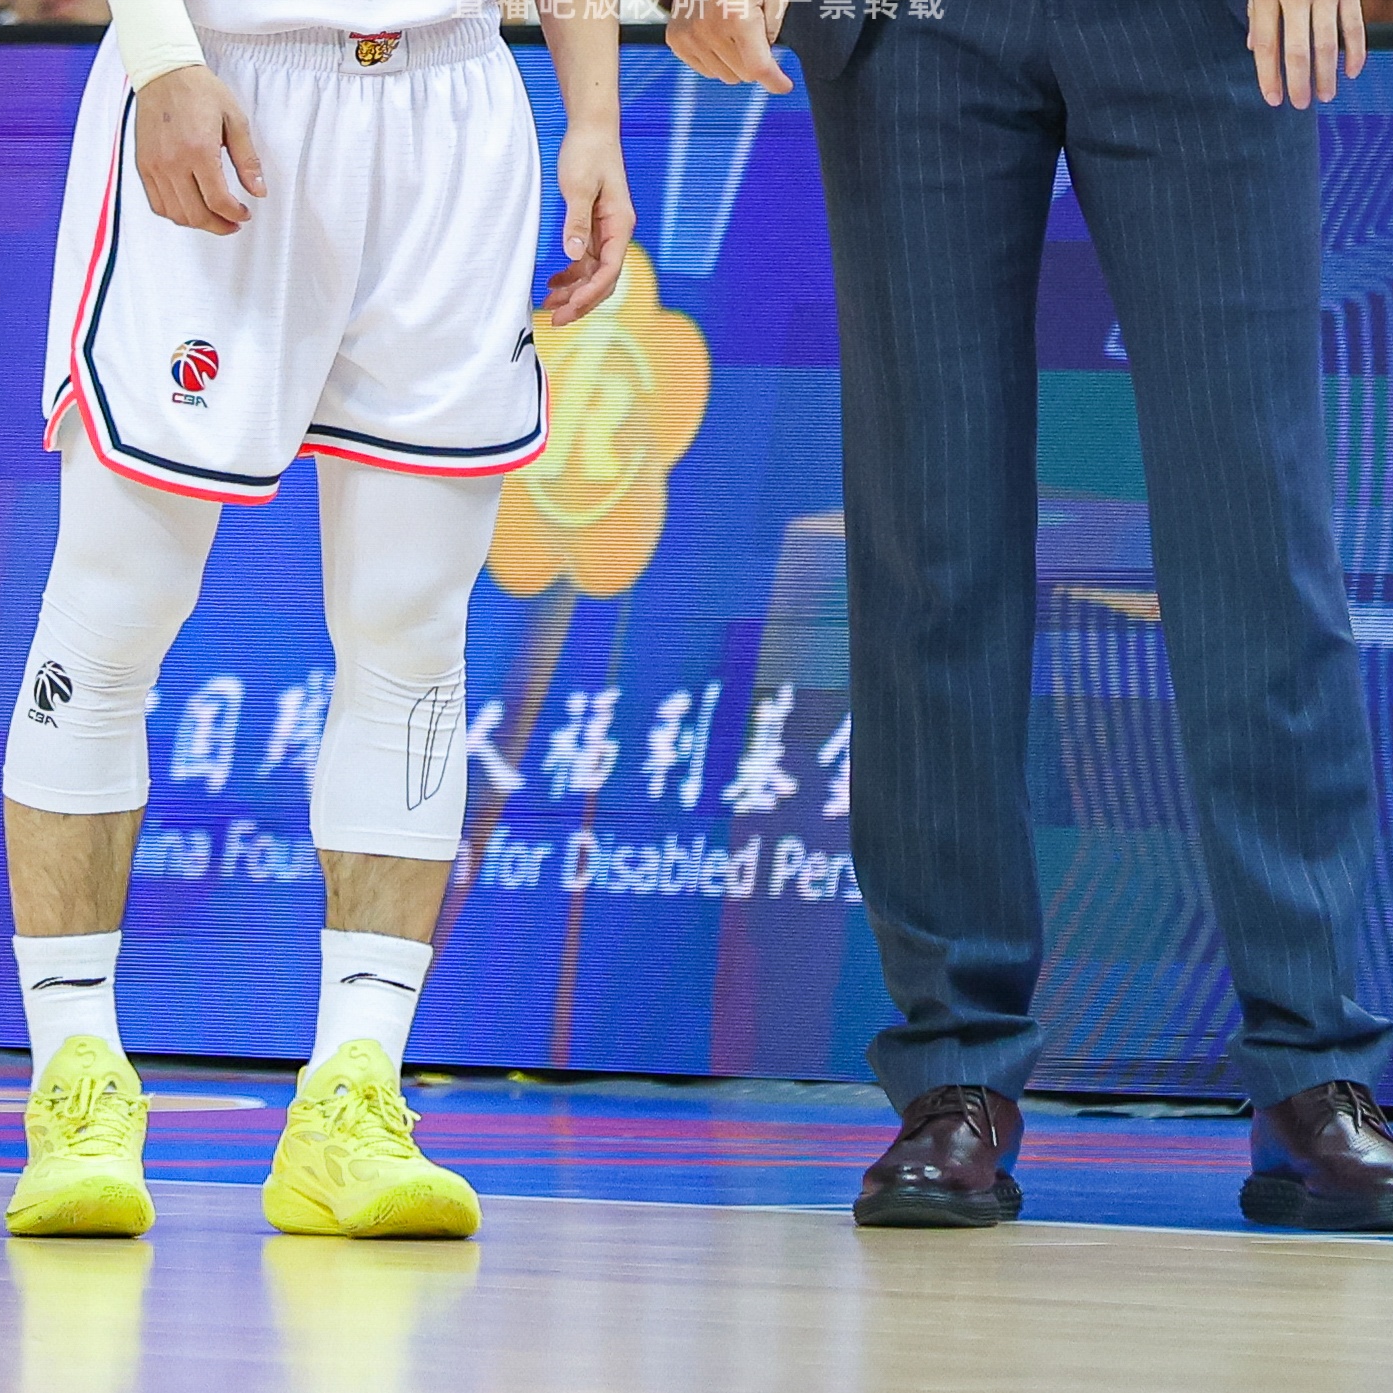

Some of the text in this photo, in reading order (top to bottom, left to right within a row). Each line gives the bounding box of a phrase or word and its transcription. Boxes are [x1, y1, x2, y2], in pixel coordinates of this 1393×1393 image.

[172, 392, 208, 409] CBA
[28, 709, 59, 729] CBA
[560, 827, 763, 900] Disabled
[767, 833, 865, 903] Pers
